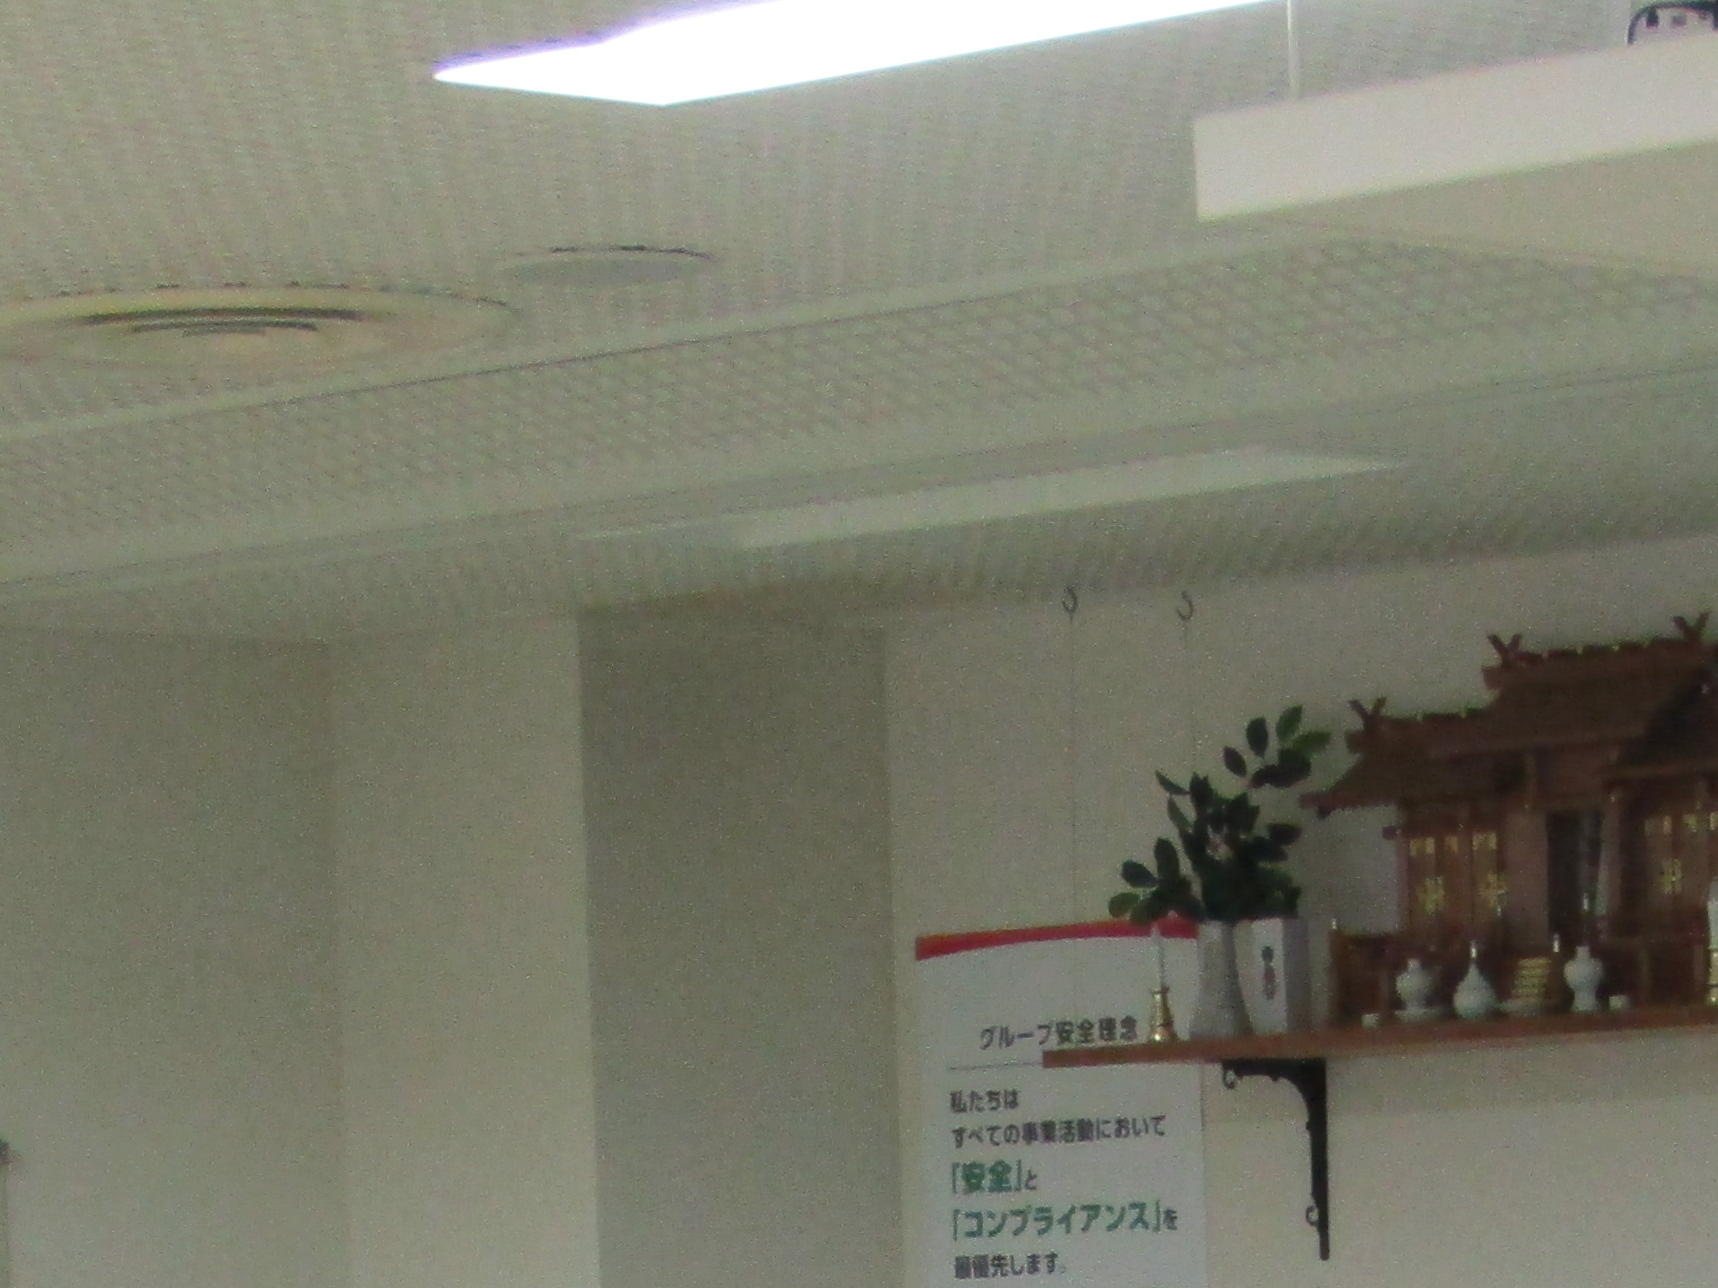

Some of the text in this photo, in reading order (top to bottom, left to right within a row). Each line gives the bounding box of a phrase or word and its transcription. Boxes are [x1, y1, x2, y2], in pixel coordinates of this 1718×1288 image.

[980, 1015, 1138, 1050] グループ安全理念
[950, 1088, 1020, 1113] 私たちは
[952, 1115, 1166, 1148] すべての事業活動において
[952, 1159, 1037, 1194] 「安全」と
[954, 1200, 1179, 1241] 「コンプライアンス」を
